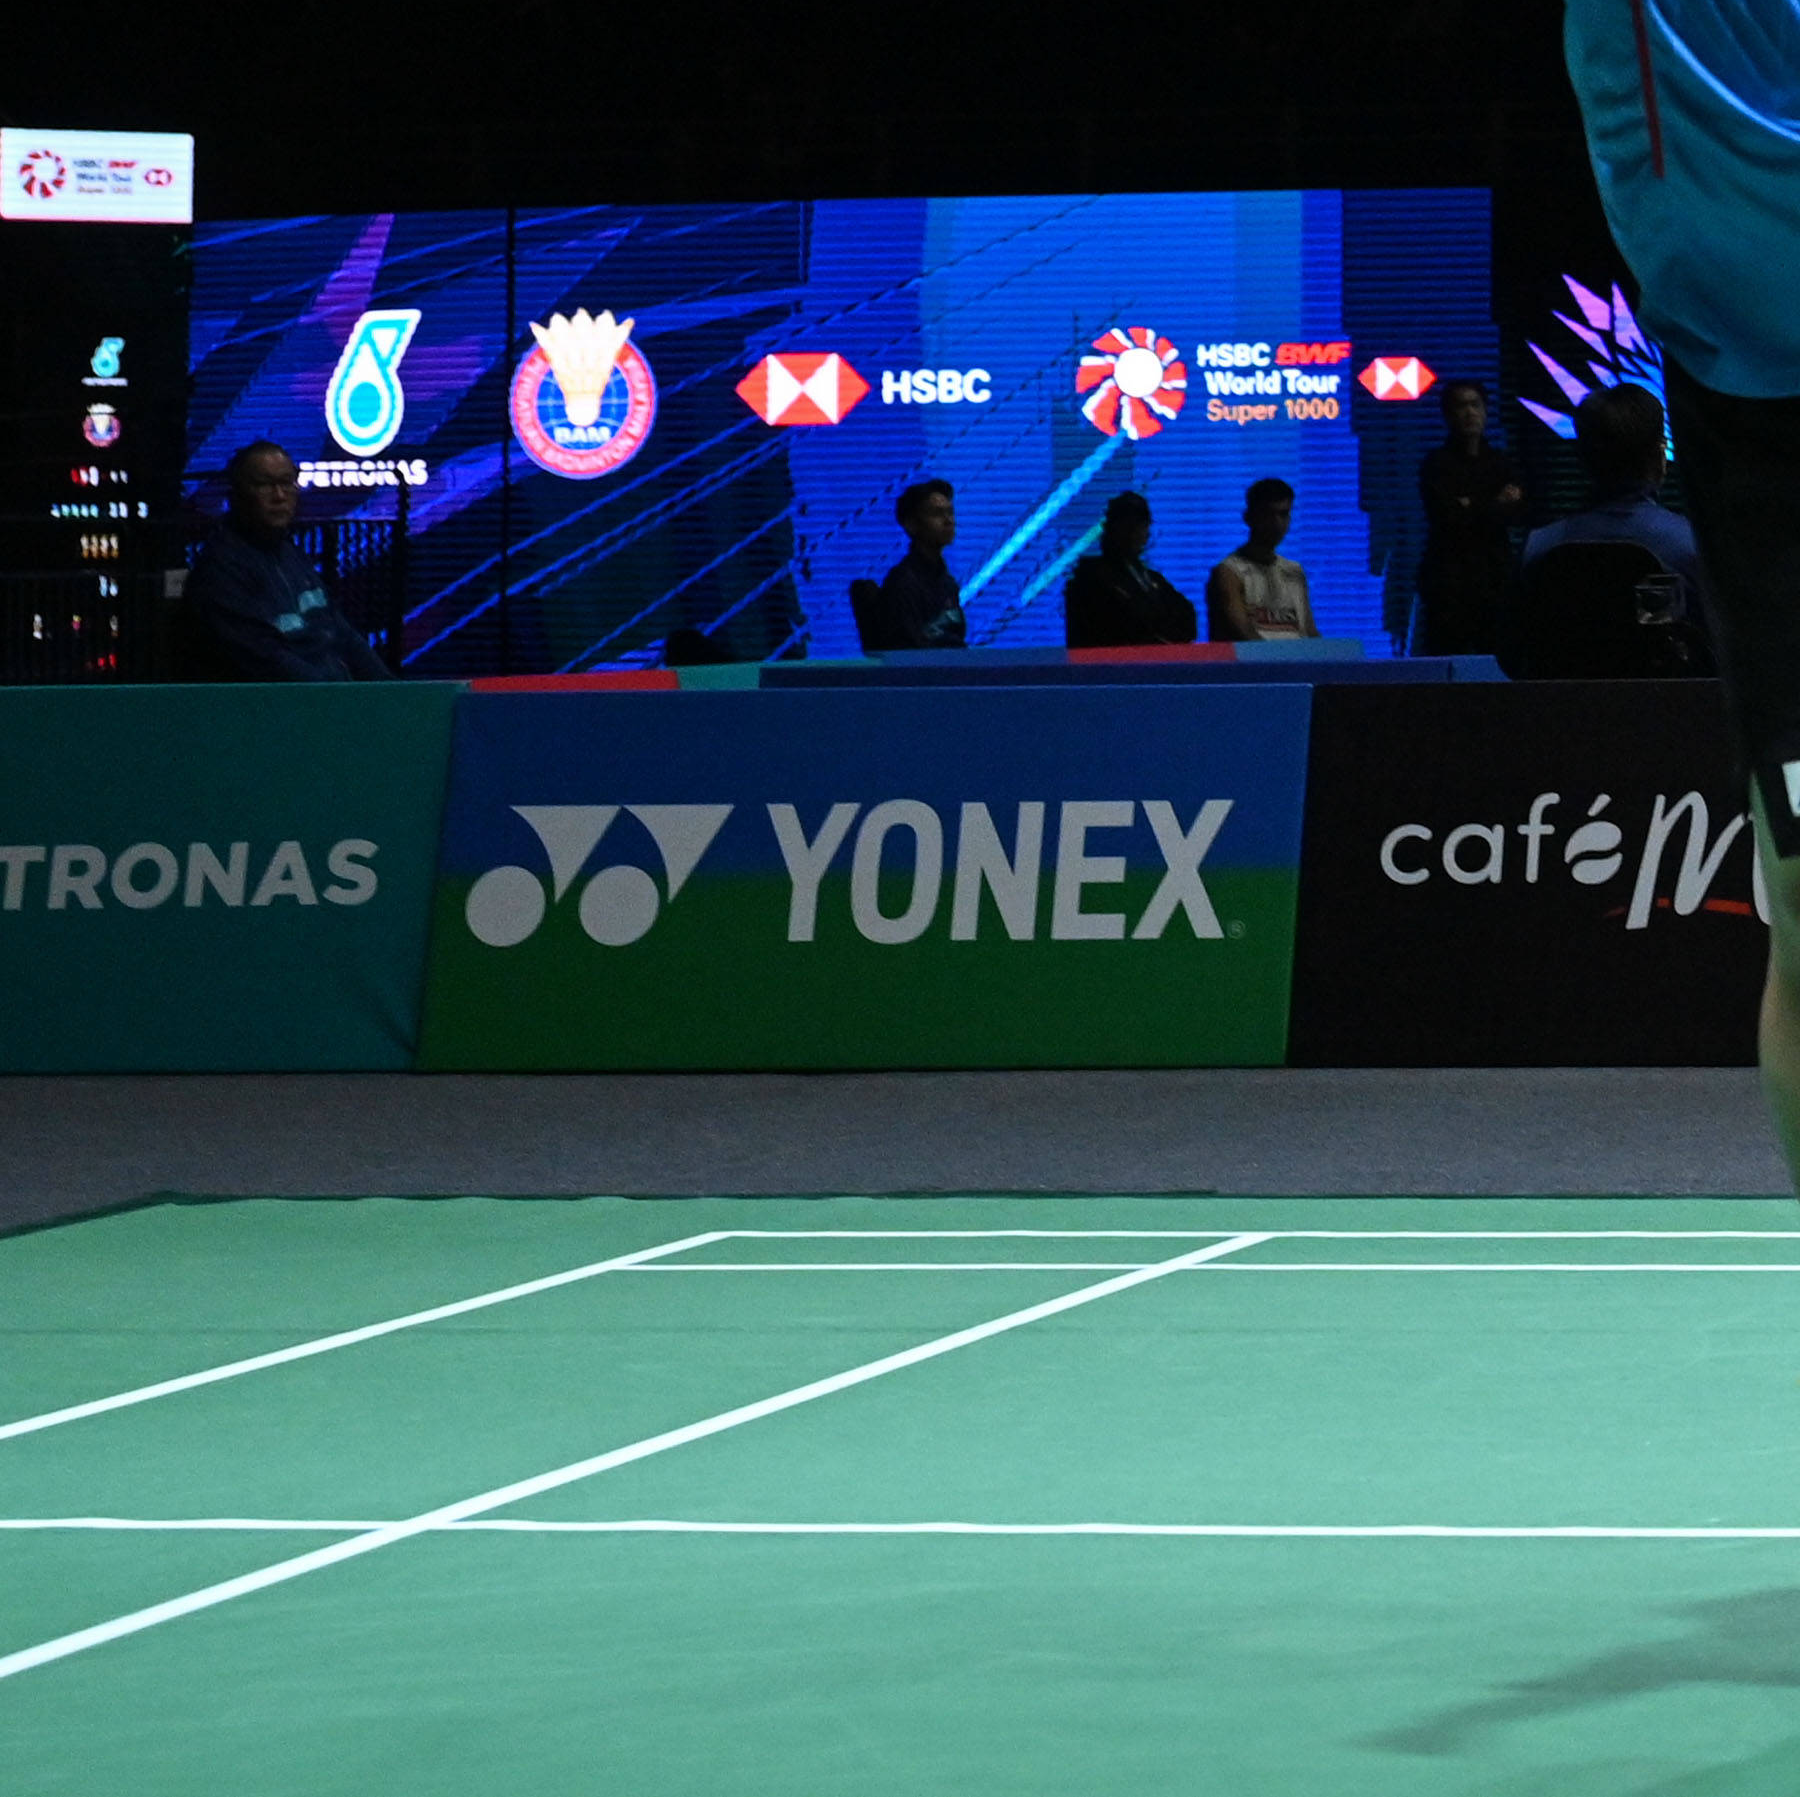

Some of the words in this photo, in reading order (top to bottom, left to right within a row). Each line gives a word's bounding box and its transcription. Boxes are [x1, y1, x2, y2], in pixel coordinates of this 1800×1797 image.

[1196, 342, 1271, 367] HSBC
[881, 369, 991, 405] HSBC
[1203, 370, 1281, 396] World
[1281, 368, 1340, 394] Tour
[1206, 398, 1278, 426] Super
[1284, 397, 1340, 420] 1000
[0, 839, 380, 911] TRONAS
[766, 799, 1234, 945] YONEX
